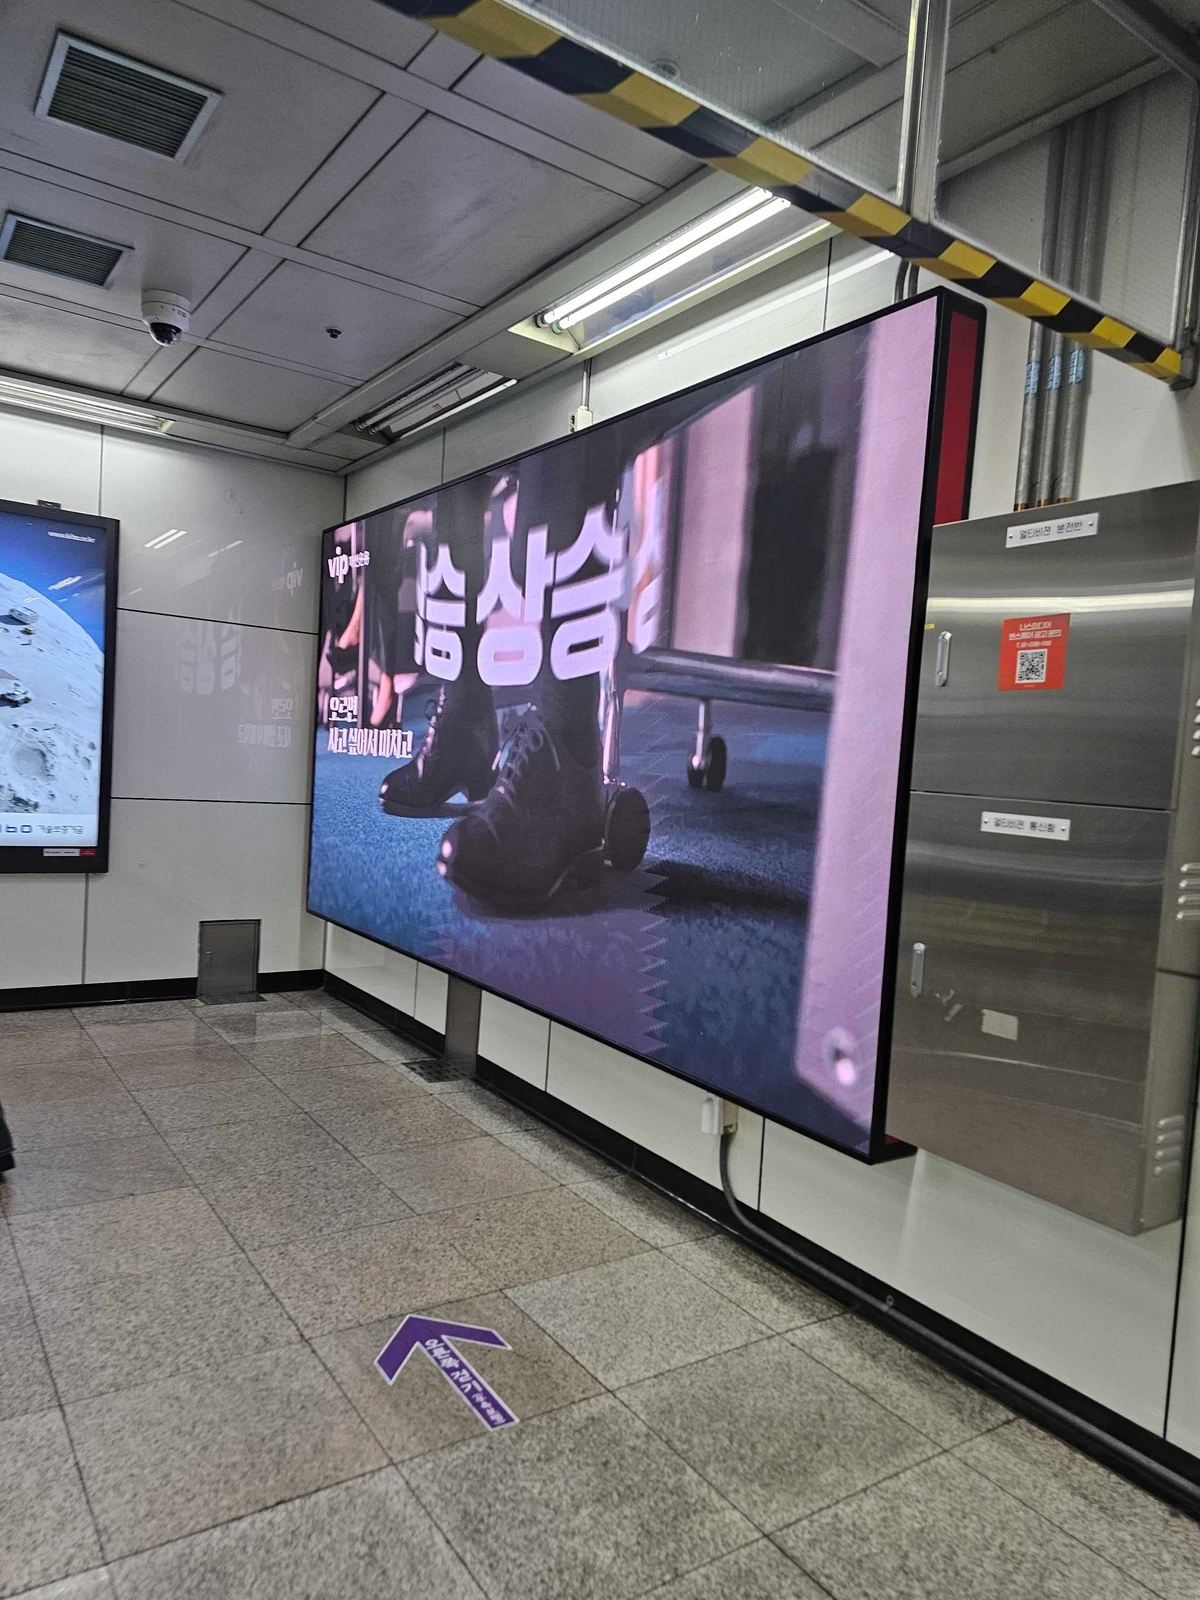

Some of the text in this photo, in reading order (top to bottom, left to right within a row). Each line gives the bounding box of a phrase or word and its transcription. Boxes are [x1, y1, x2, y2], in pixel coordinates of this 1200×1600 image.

[1056, 521, 1083, 534] 분전반
[328, 546, 350, 584] vip
[1019, 620, 1052, 631] 나스미디어
[328, 695, 358, 723] 오르면
[327, 727, 414, 759] 사고 싶어서 미치고
[450, 1368, 483, 1393] 걷기
